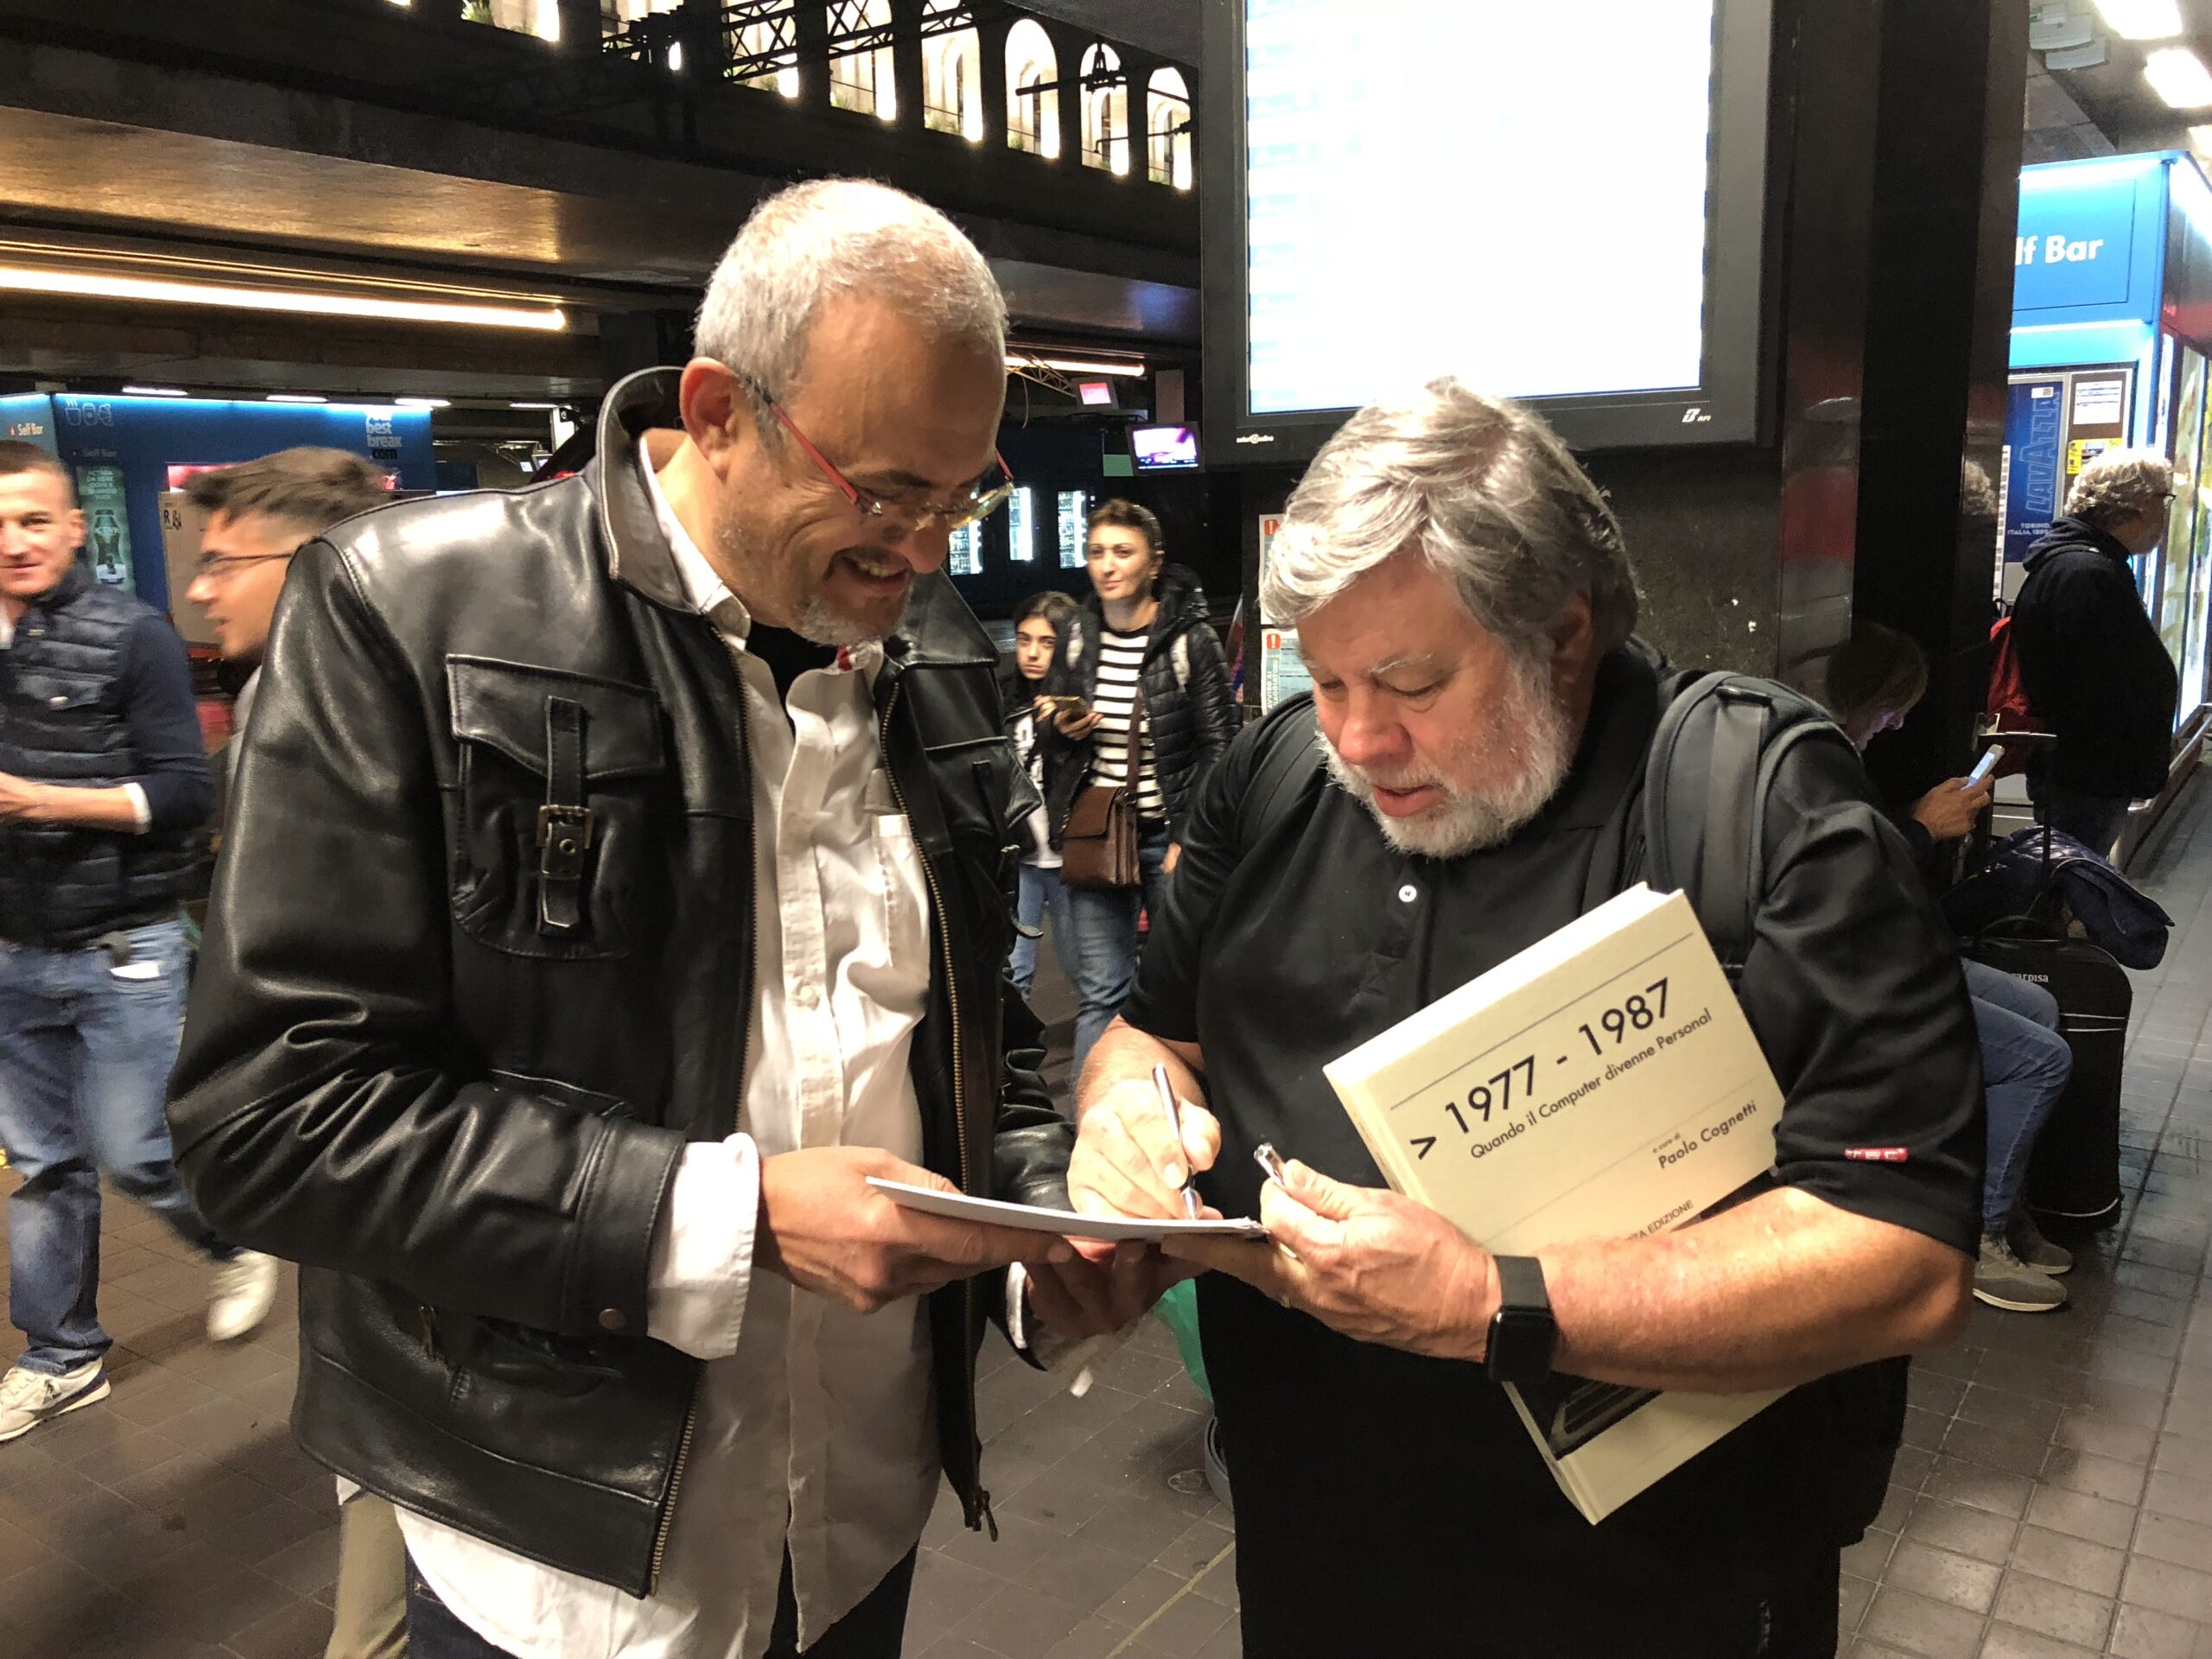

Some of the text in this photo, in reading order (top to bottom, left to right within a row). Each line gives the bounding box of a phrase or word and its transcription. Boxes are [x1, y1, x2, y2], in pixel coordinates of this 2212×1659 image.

[2015, 234, 2104, 266] lf Bar
[2018, 391, 2061, 513] LAVAZZA
[1446, 1054, 1535, 1135] 1977
[1556, 1055, 1568, 1065] -
[1579, 976, 1669, 1056] 1987
[1471, 1007, 1713, 1159] Quando il Computer divenne Personal
[1658, 1100, 1758, 1169] Paolo Cognetti
[1647, 1198, 1694, 1234] EDIZIONE
